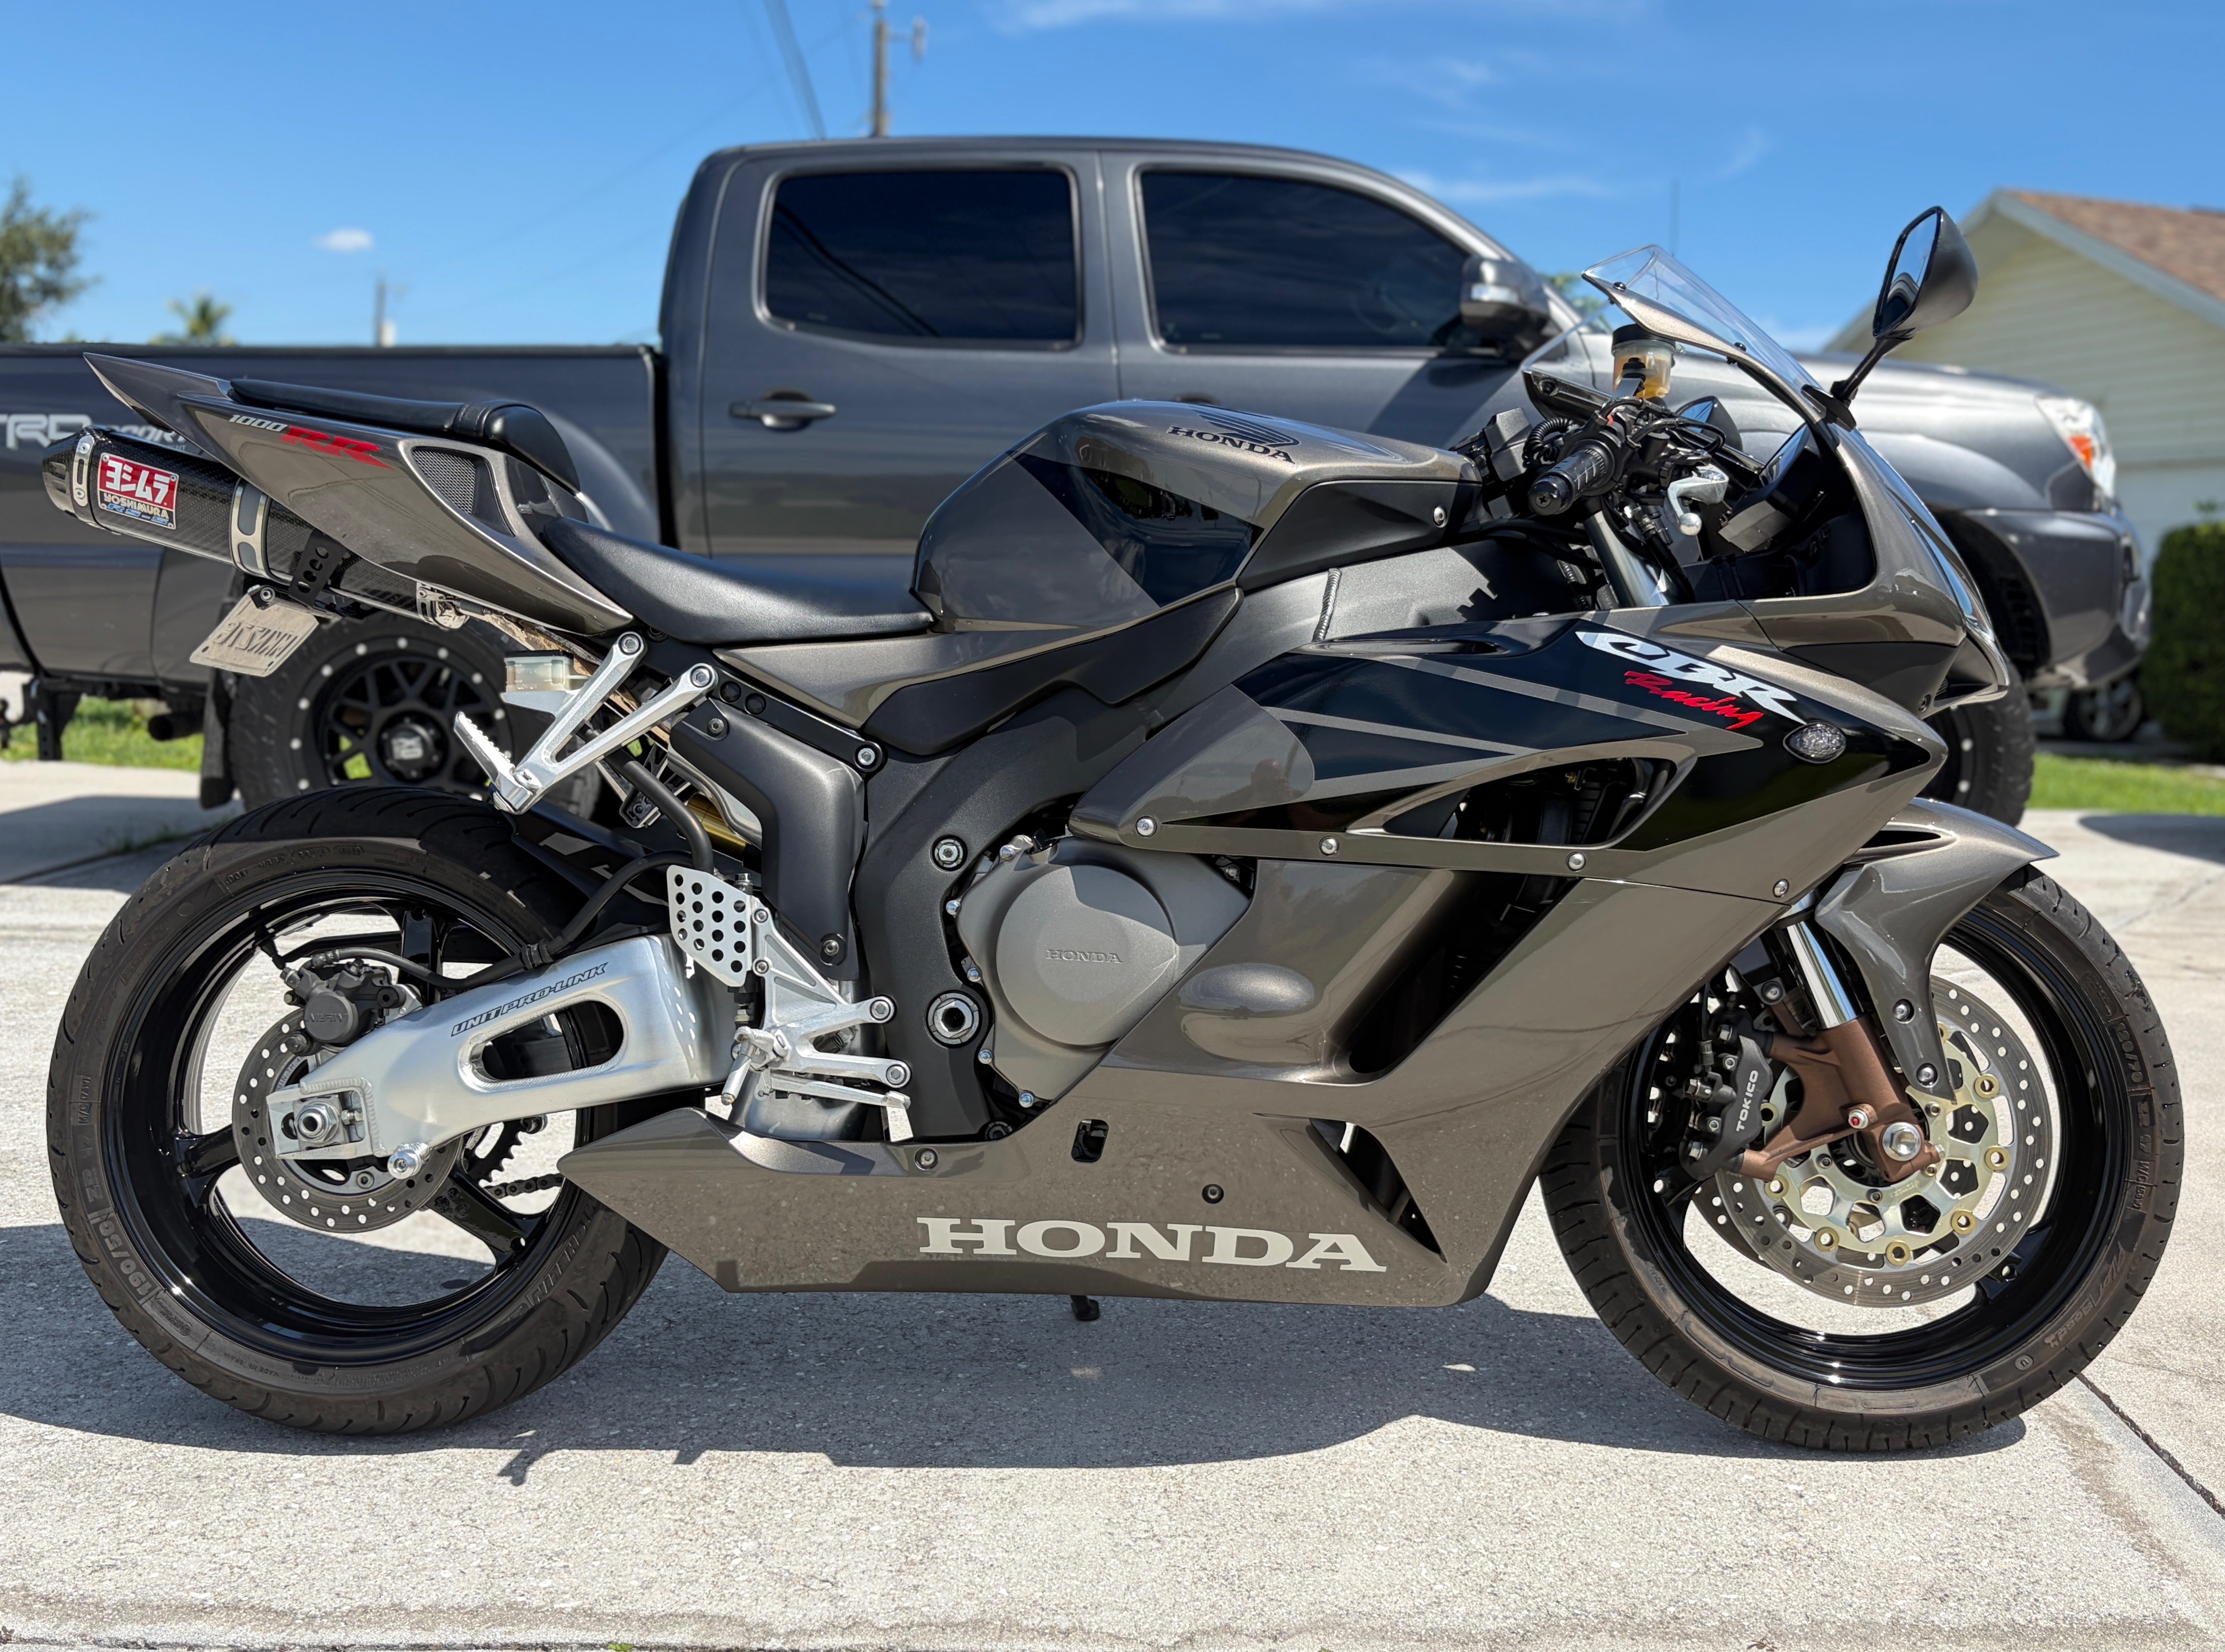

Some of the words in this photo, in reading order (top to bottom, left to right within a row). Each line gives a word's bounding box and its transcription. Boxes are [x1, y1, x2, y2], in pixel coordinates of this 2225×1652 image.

[0, 414, 94, 450] RD
[229, 414, 288, 432] 1000
[1167, 426, 1295, 464] HONDA
[106, 460, 170, 504] ヨシムラ
[104, 493, 169, 520] YOSHIMURA
[1575, 631, 1807, 725] CBR
[1624, 670, 1764, 729] Racing
[1046, 949, 1123, 964] HONDA
[451, 1006, 502, 1036] UNIT
[500, 962, 609, 1016] PRO-LINK
[2116, 1022, 2143, 1084] 120/70
[1736, 1070, 1758, 1132] TOKICO
[82, 1168, 103, 1203] ZR
[99, 1221, 152, 1297] 190/50
[916, 1217, 1387, 1272] HONDA
[1648, 1267, 1668, 1292] RADIAL
